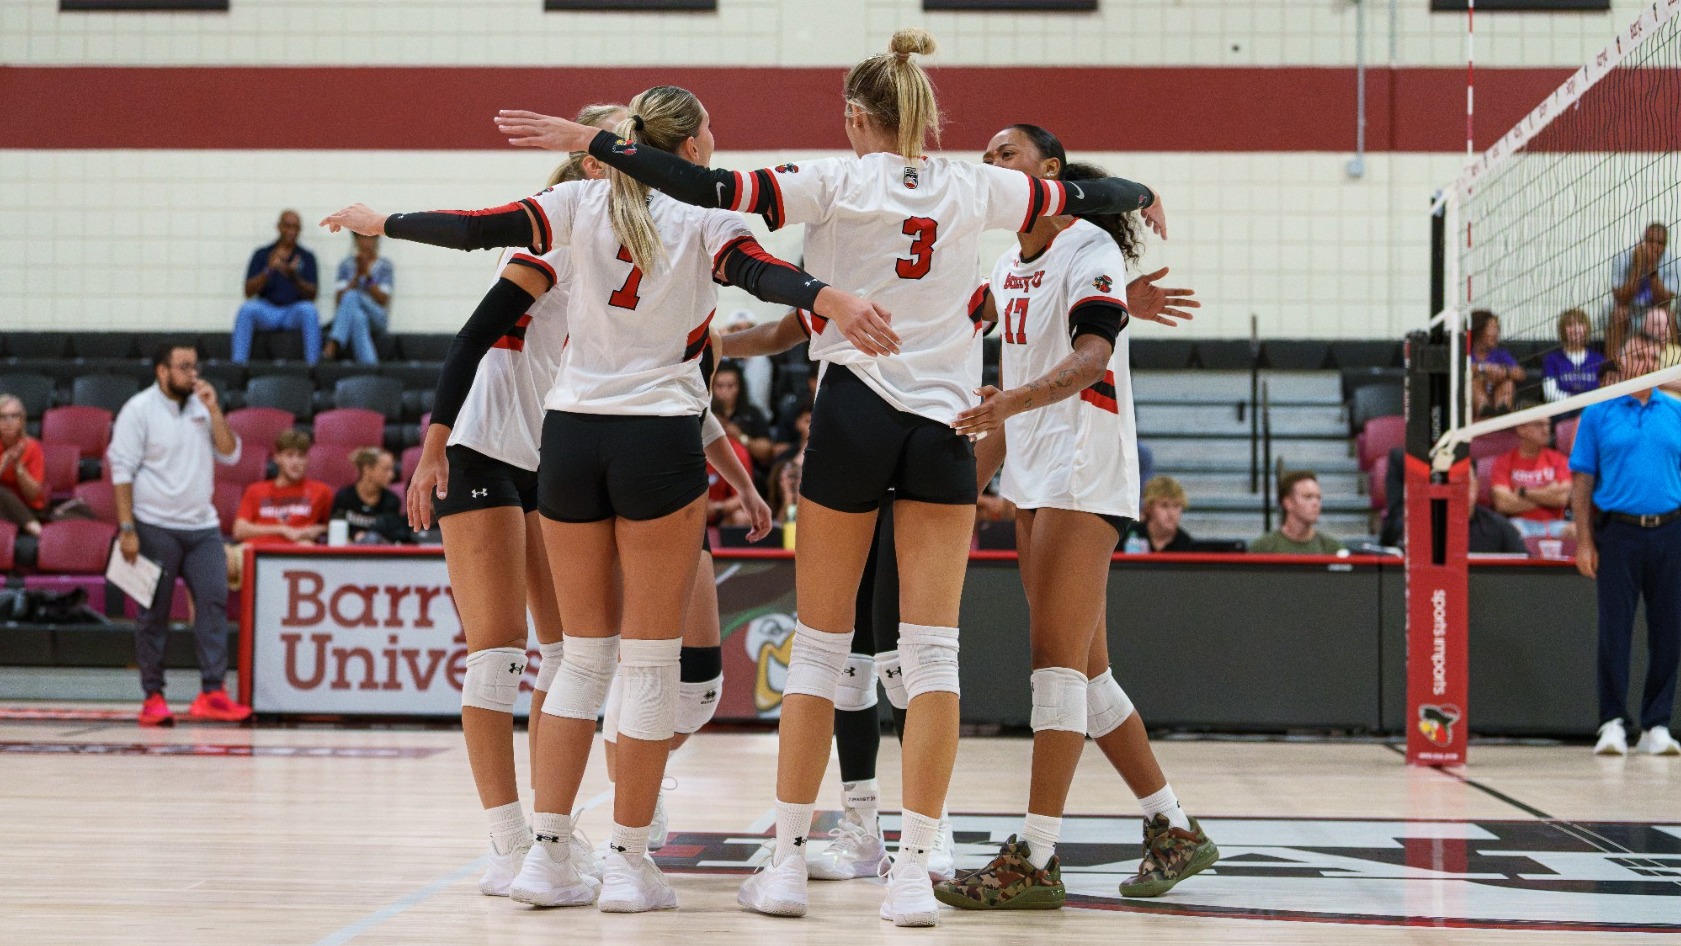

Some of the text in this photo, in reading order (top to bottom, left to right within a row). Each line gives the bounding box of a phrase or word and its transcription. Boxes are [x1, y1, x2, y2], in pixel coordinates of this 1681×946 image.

[895, 216, 938, 280] 3
[1031, 270, 1045, 288] U
[1005, 298, 1030, 345] 17
[280, 570, 466, 644] Barr
[1431, 589, 1447, 695] sports imports
